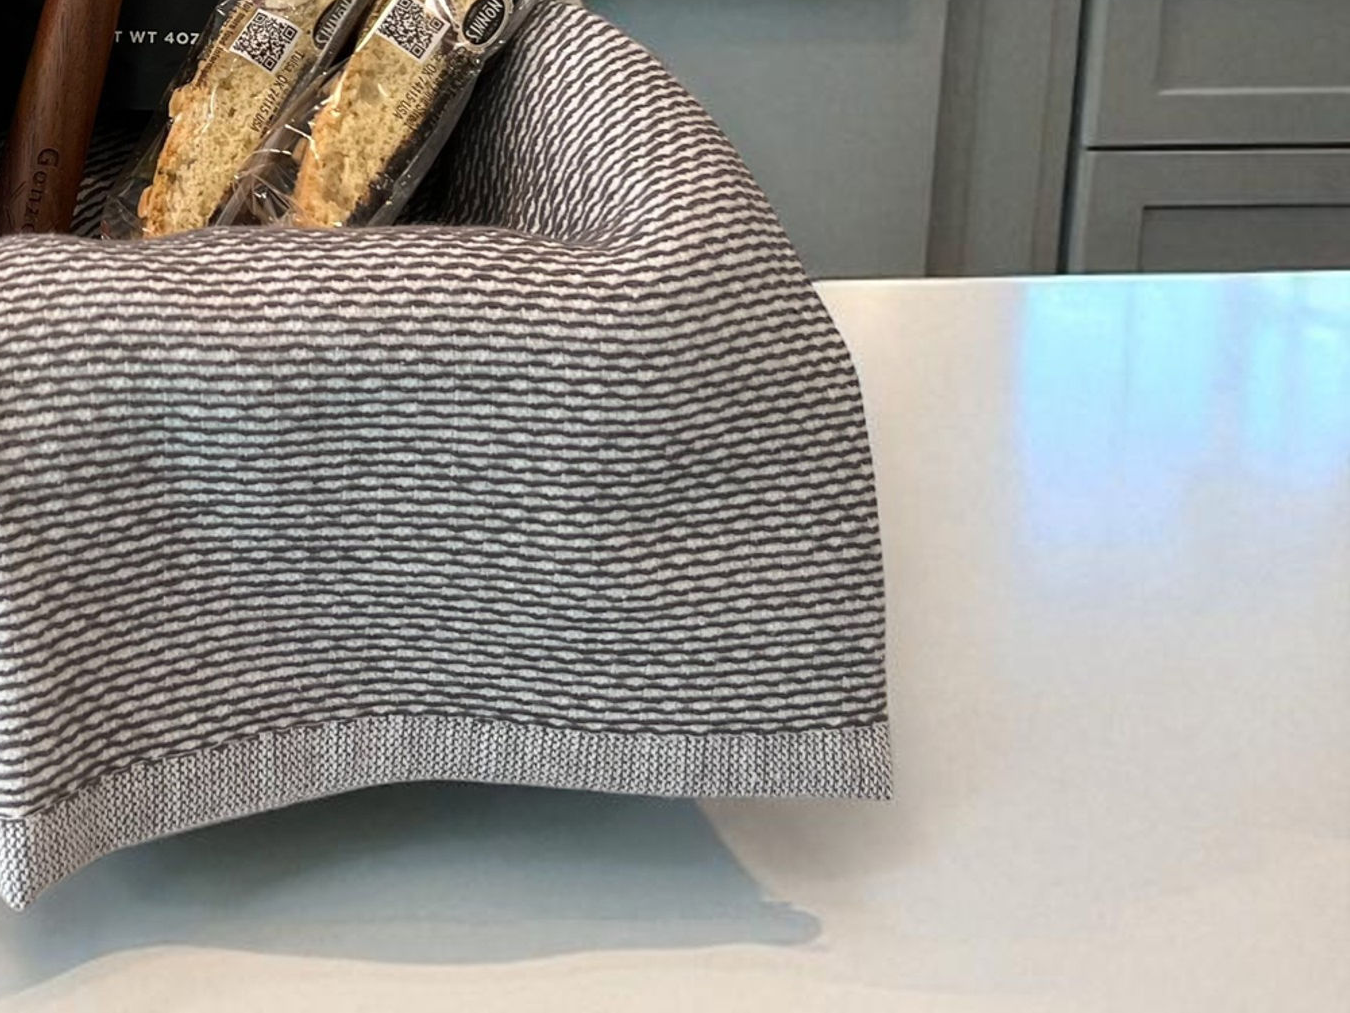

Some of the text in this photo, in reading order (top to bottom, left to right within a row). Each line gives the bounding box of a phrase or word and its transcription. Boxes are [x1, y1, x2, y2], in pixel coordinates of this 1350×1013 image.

[129, 31, 158, 43] WT
[272, 73, 288, 90] OK
[420, 62, 438, 79] OK
[403, 75, 428, 104] 74115
[256, 87, 281, 116] 74115
[391, 98, 411, 121] USA
[247, 111, 267, 134] USA
